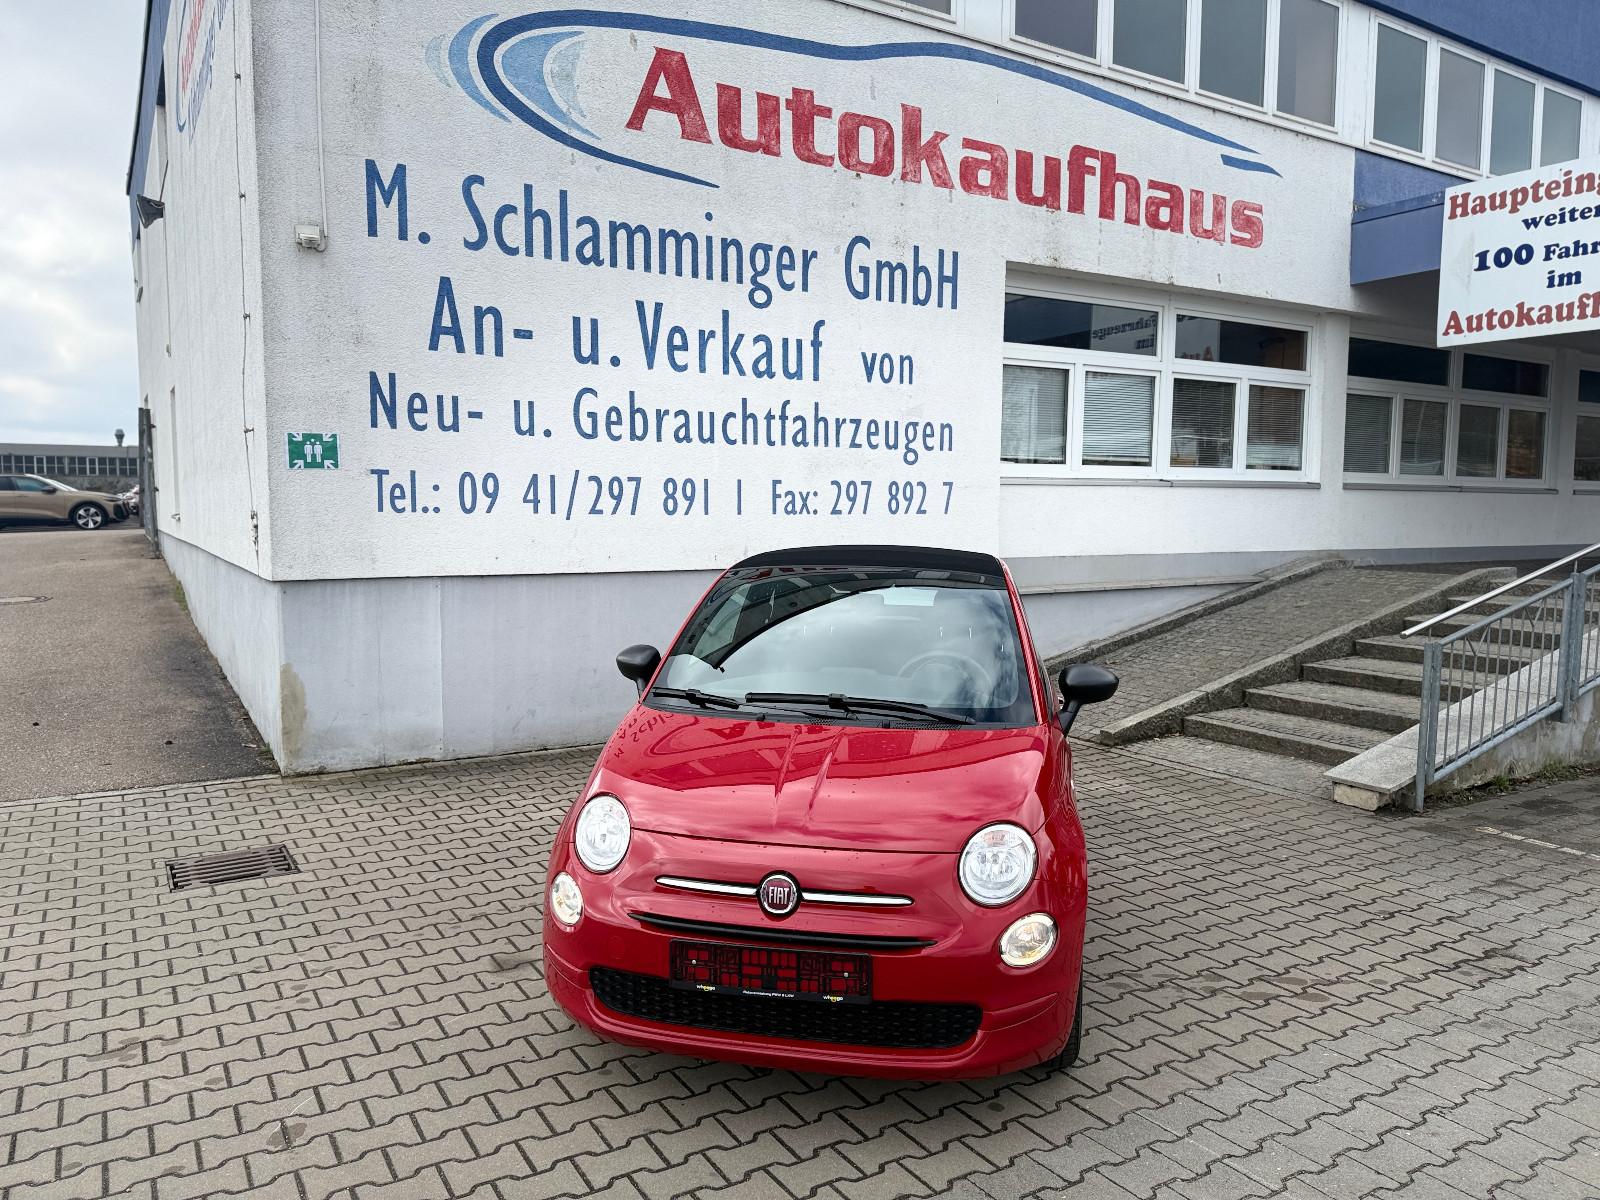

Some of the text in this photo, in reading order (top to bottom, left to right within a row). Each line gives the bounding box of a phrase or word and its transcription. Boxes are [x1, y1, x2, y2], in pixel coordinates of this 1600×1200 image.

[628, 48, 1264, 248] Autokaufhaus
[1447, 170, 1600, 220] Hauptein
[364, 159, 960, 311] M. Schlamminger GmbH
[1474, 243, 1535, 272] 100
[1546, 269, 1582, 288] im
[428, 275, 915, 385] An- u. Verkauf von
[369, 370, 954, 465] Neu- u. Gebrauchtfahrzeugen
[371, 468, 441, 514] Tel.:
[458, 471, 500, 515] 09
[523, 470, 644, 521] 41/297
[661, 477, 712, 516] 891
[771, 479, 820, 516] Fax:
[831, 479, 873, 516] 297
[886, 480, 929, 514] 892
[942, 481, 954, 514] 7
[769, 886, 790, 905] FIAT
